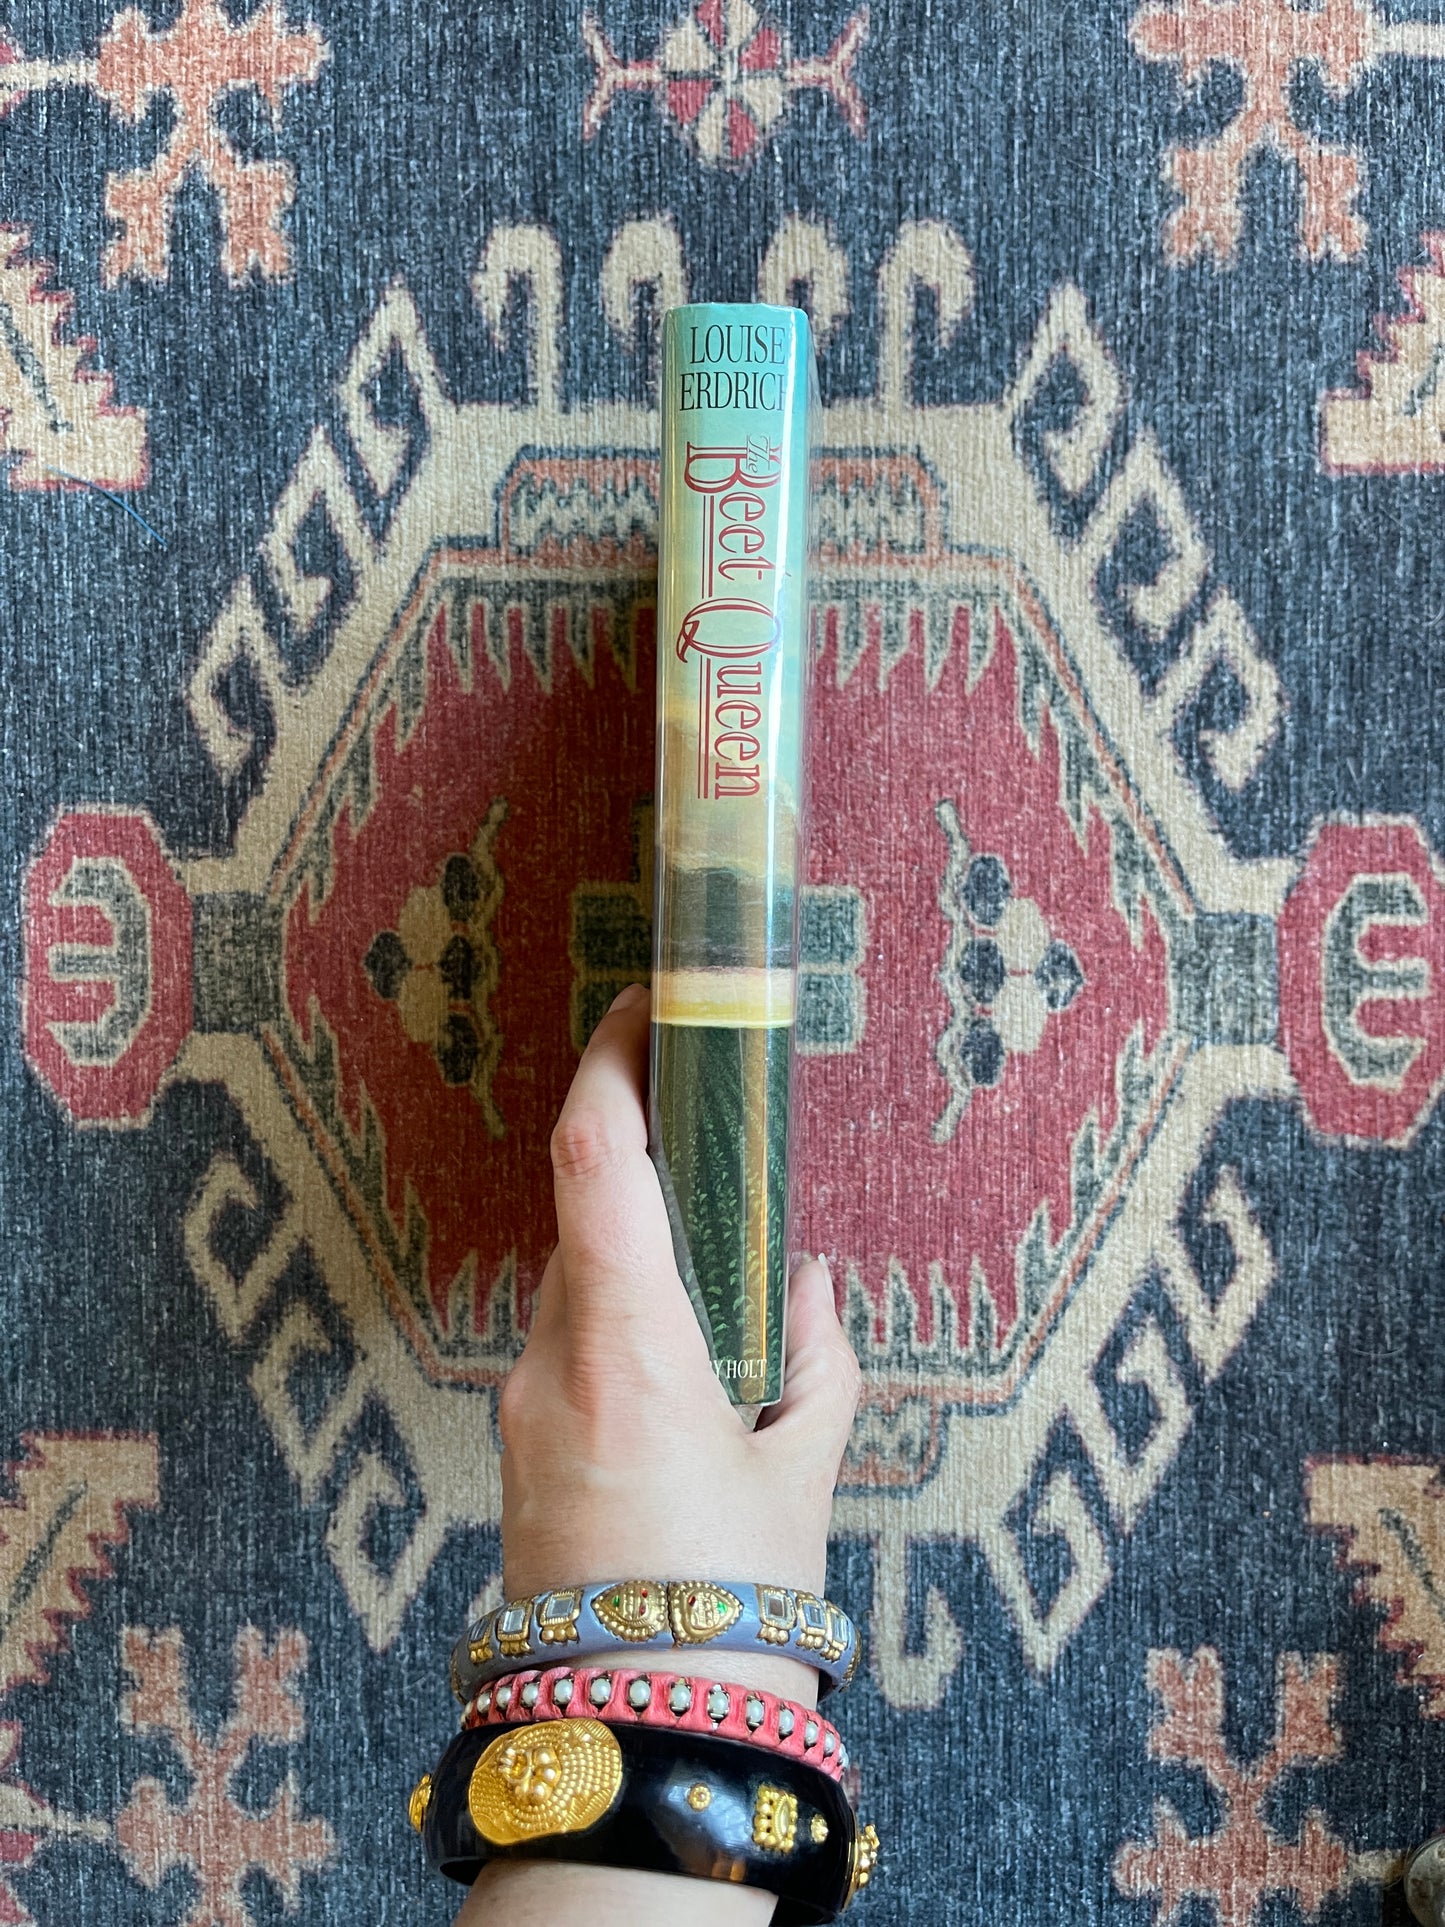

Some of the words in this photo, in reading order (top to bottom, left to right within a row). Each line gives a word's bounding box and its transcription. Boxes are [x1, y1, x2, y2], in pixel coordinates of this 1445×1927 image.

[689, 324, 785, 364] LOUISE
[747, 435, 770, 473] The
[683, 441, 783, 580] Beet
[676, 597, 780, 800] Queen
[726, 1359, 767, 1378] HOLT
